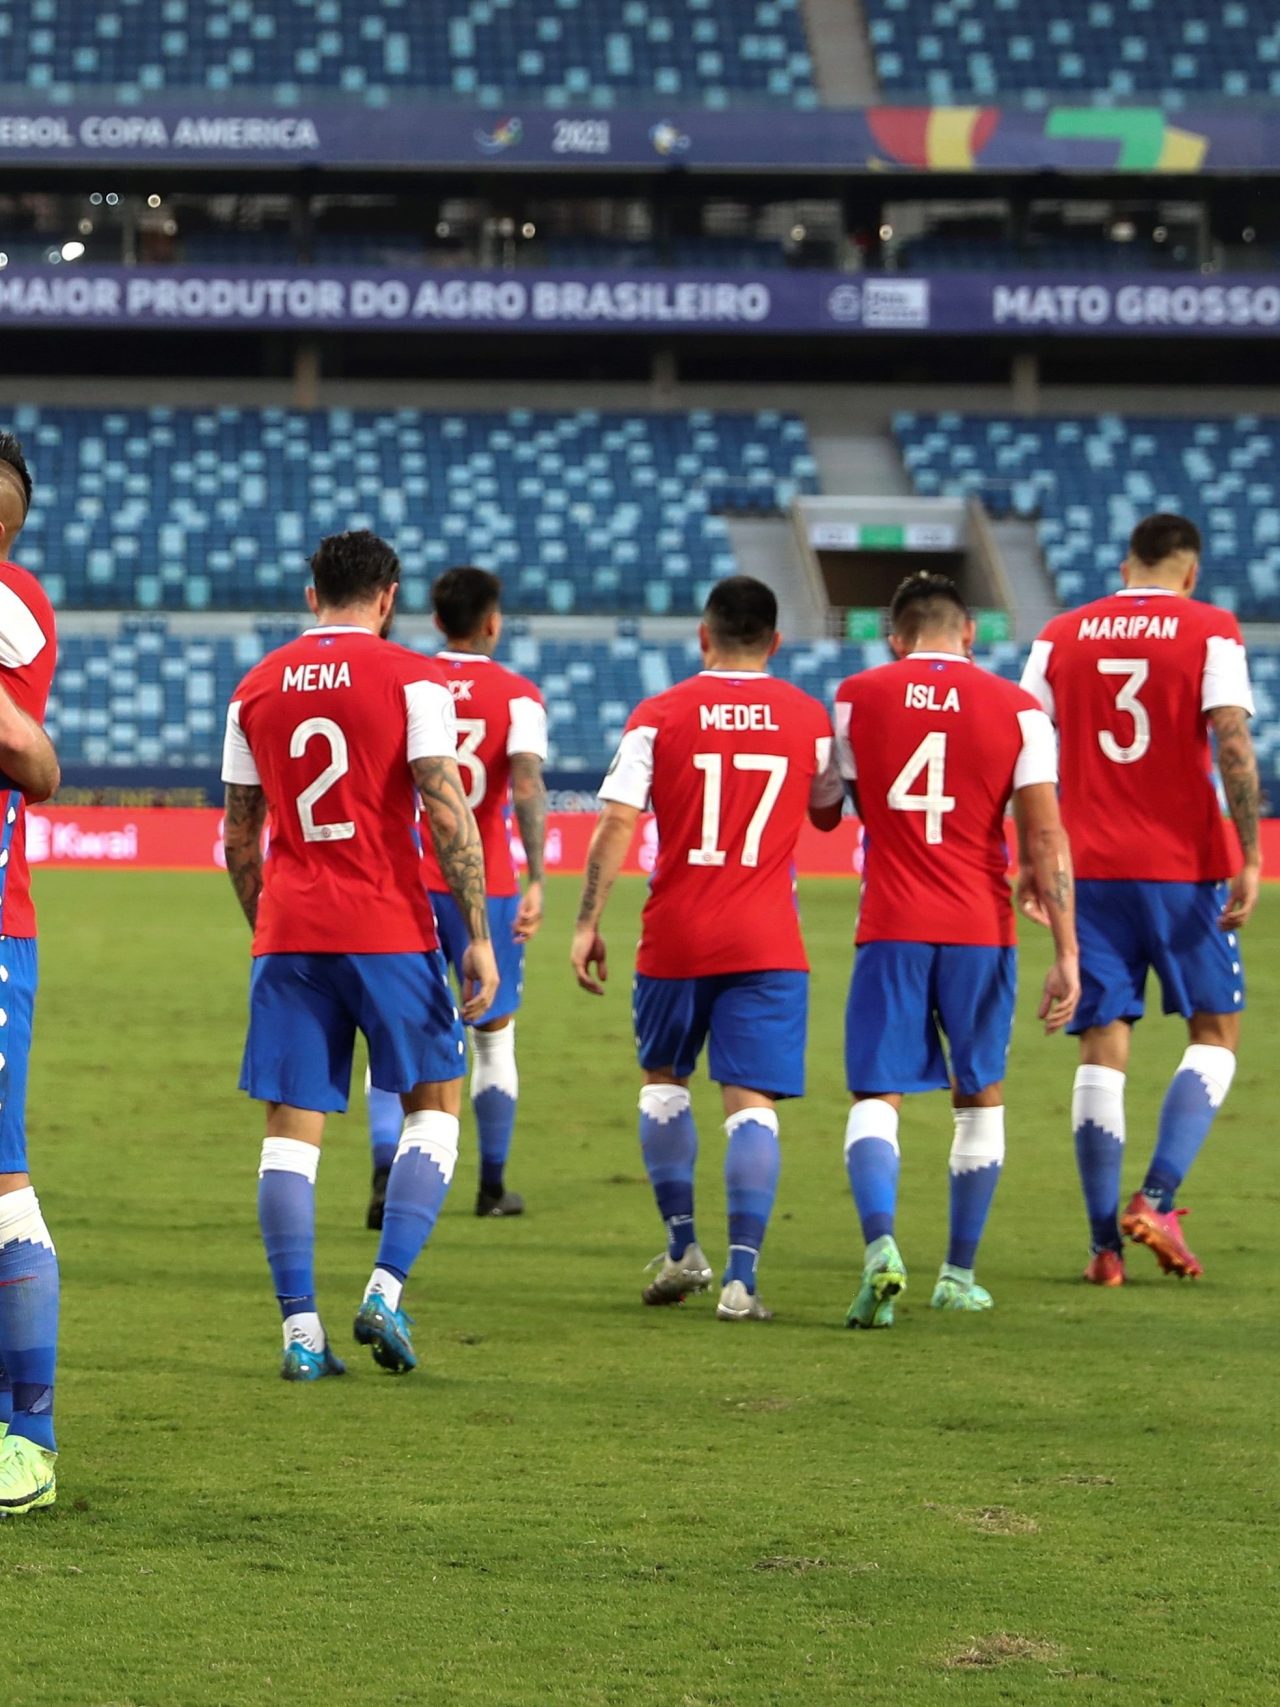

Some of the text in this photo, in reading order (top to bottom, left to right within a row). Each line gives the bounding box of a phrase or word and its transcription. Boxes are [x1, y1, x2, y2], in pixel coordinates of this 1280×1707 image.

[79, 116, 169, 148] COPA
[172, 117, 319, 150] AMERICA
[552, 118, 610, 153] 2021
[127, 278, 346, 318] PRODUTOR
[350, 279, 410, 319] DO
[413, 280, 527, 319] AGRO
[532, 281, 770, 321] BRASILEIRO
[993, 285, 1280, 325] MATO GROSSO
[1078, 615, 1179, 641] MARIPAN
[281, 661, 352, 693] MENA
[904, 682, 961, 713] ISLA
[1097, 658, 1151, 764] 3
[699, 703, 780, 731] MEDEL
[289, 716, 356, 842] 2
[455, 718, 487, 809] 3
[886, 731, 956, 844] 4
[687, 753, 789, 867] 17
[52, 822, 138, 859] Kwai
